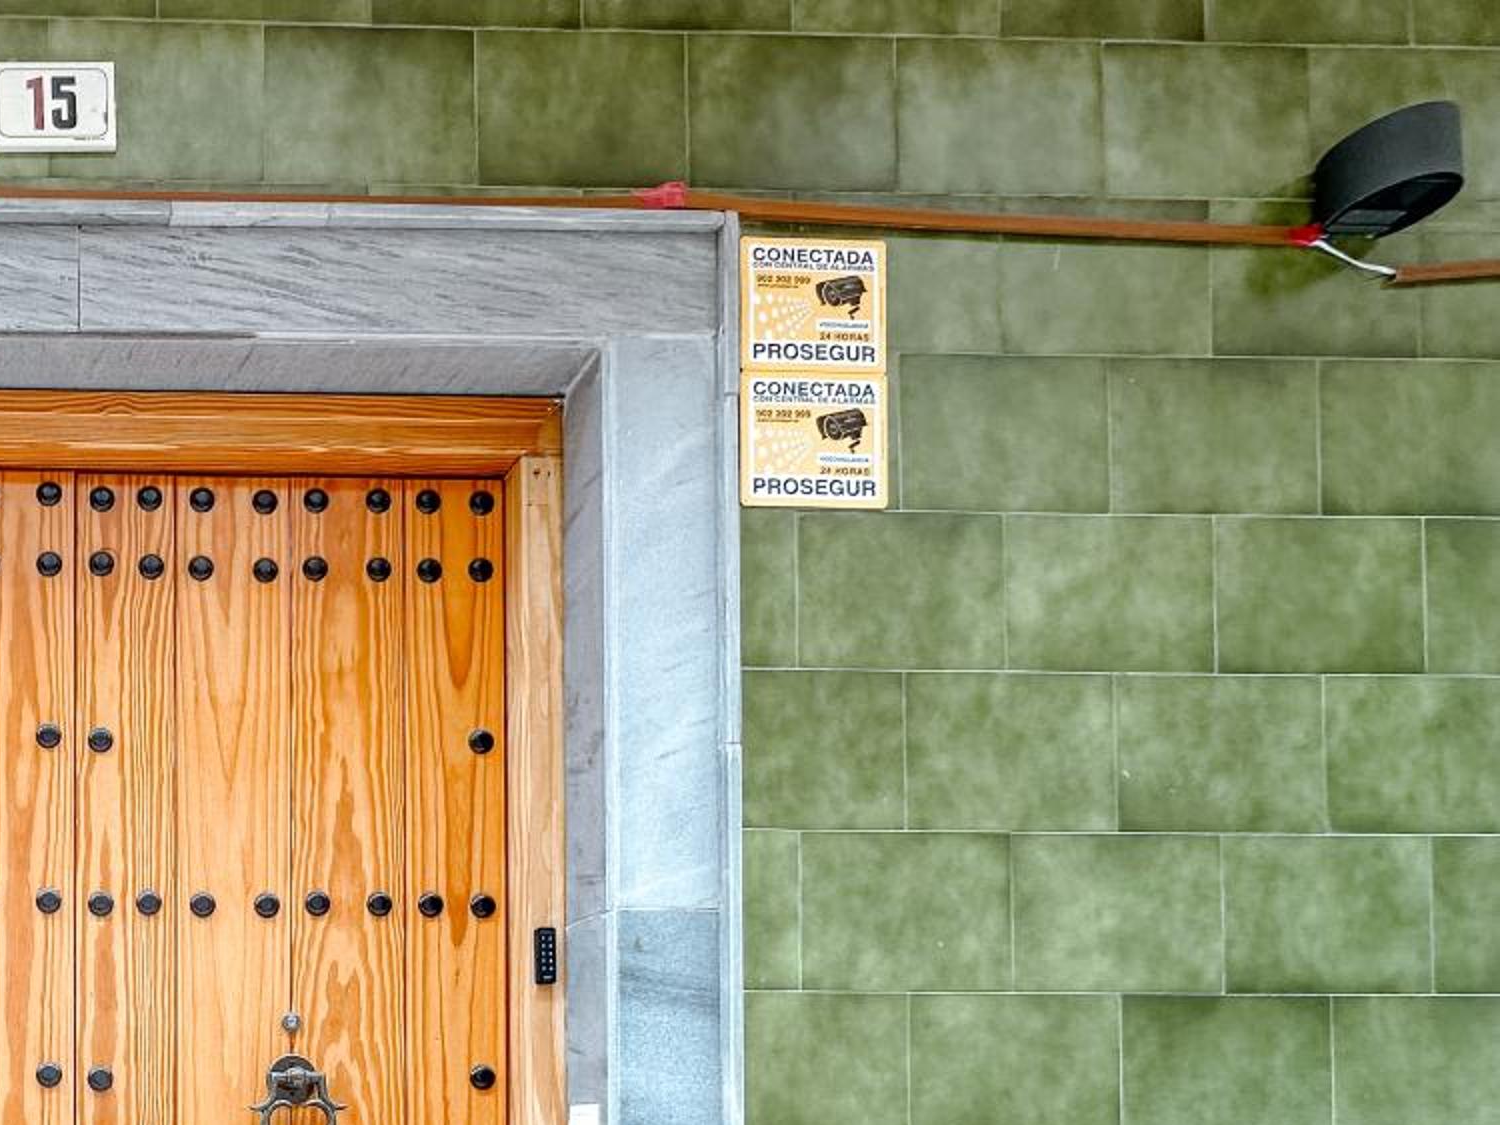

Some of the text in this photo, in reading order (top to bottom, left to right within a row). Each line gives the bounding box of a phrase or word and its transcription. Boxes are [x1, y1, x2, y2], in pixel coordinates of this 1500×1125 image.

[25, 75, 77, 130] 15
[753, 247, 873, 265] CONECTADA
[753, 343, 875, 362] PROSEGUR
[753, 381, 875, 398] CONECTADA
[753, 477, 876, 497] PROSEGUR
